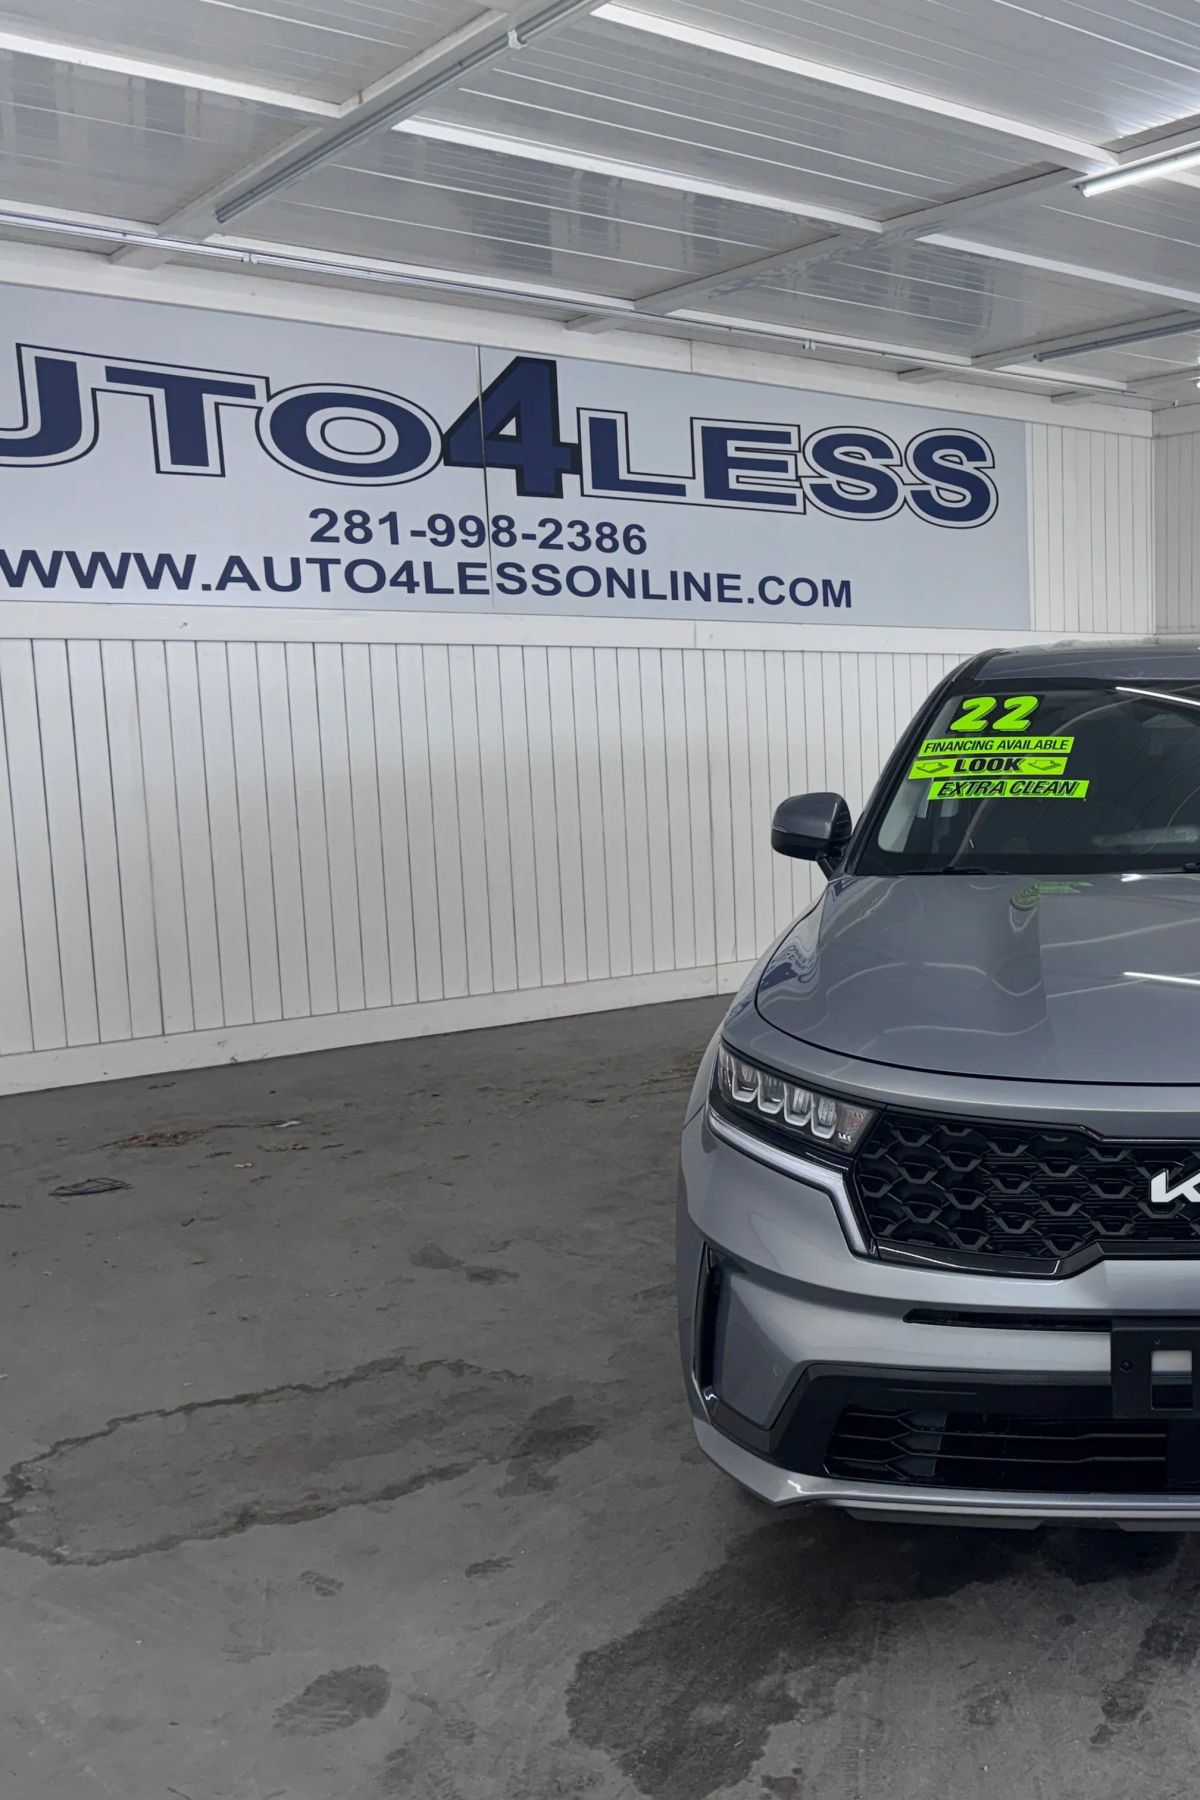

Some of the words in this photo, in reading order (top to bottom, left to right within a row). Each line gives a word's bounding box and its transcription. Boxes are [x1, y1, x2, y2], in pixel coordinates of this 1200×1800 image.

[309, 508, 648, 555] 281-998-2386
[0, 549, 852, 608] WWW.AUTO4LESSONLINE.COM
[950, 695, 1040, 732] 22
[923, 740, 993, 753] FINANCING
[996, 739, 1069, 750] AVAILABLE
[953, 757, 1026, 774] LOOK
[937, 780, 1008, 798] EXTRA
[1009, 780, 1081, 797] CLEAN
